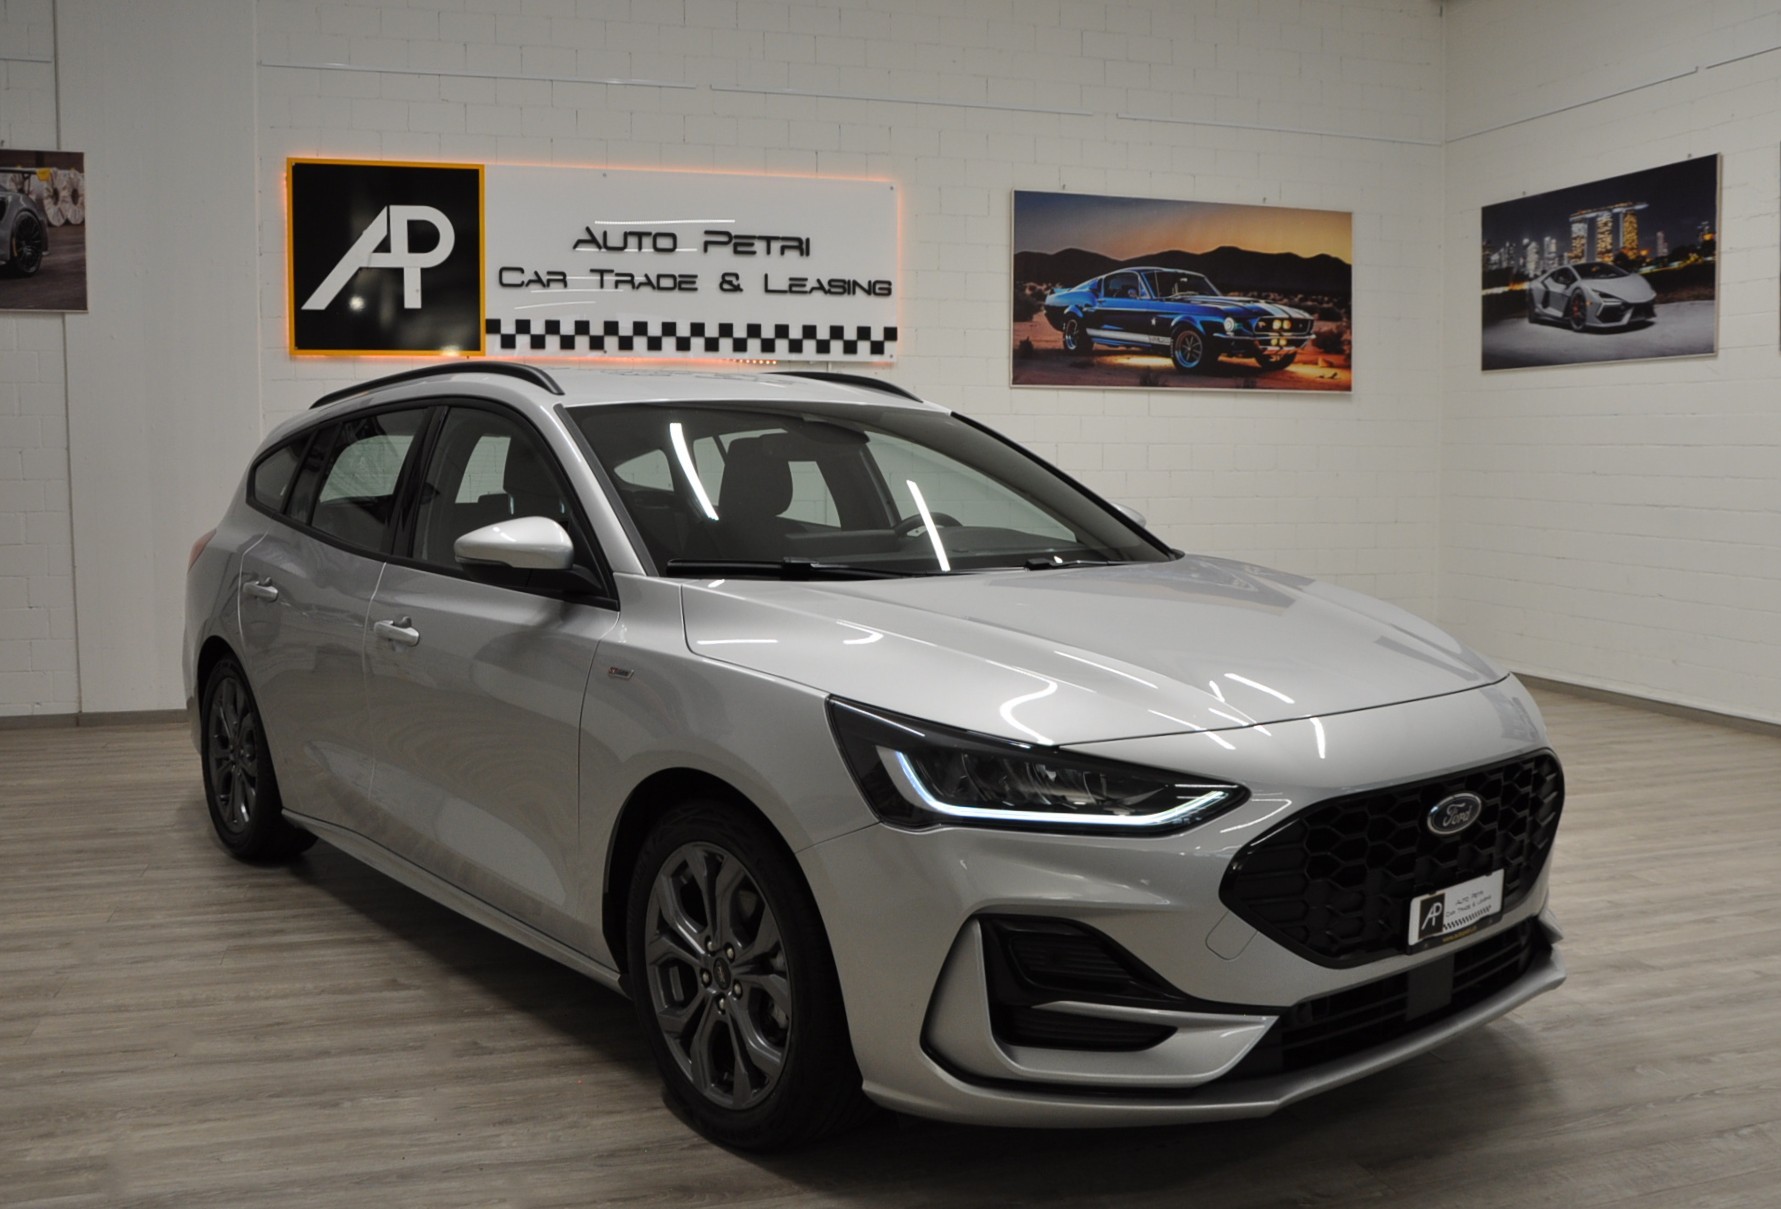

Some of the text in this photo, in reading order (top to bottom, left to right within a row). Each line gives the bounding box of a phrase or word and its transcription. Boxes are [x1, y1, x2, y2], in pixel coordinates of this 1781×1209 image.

[573, 226, 810, 257] AUTO PETRI
[301, 205, 455, 310] AP
[499, 266, 892, 296] CAR TRADE & LEASING
[1442, 802, 1473, 827] Ford
